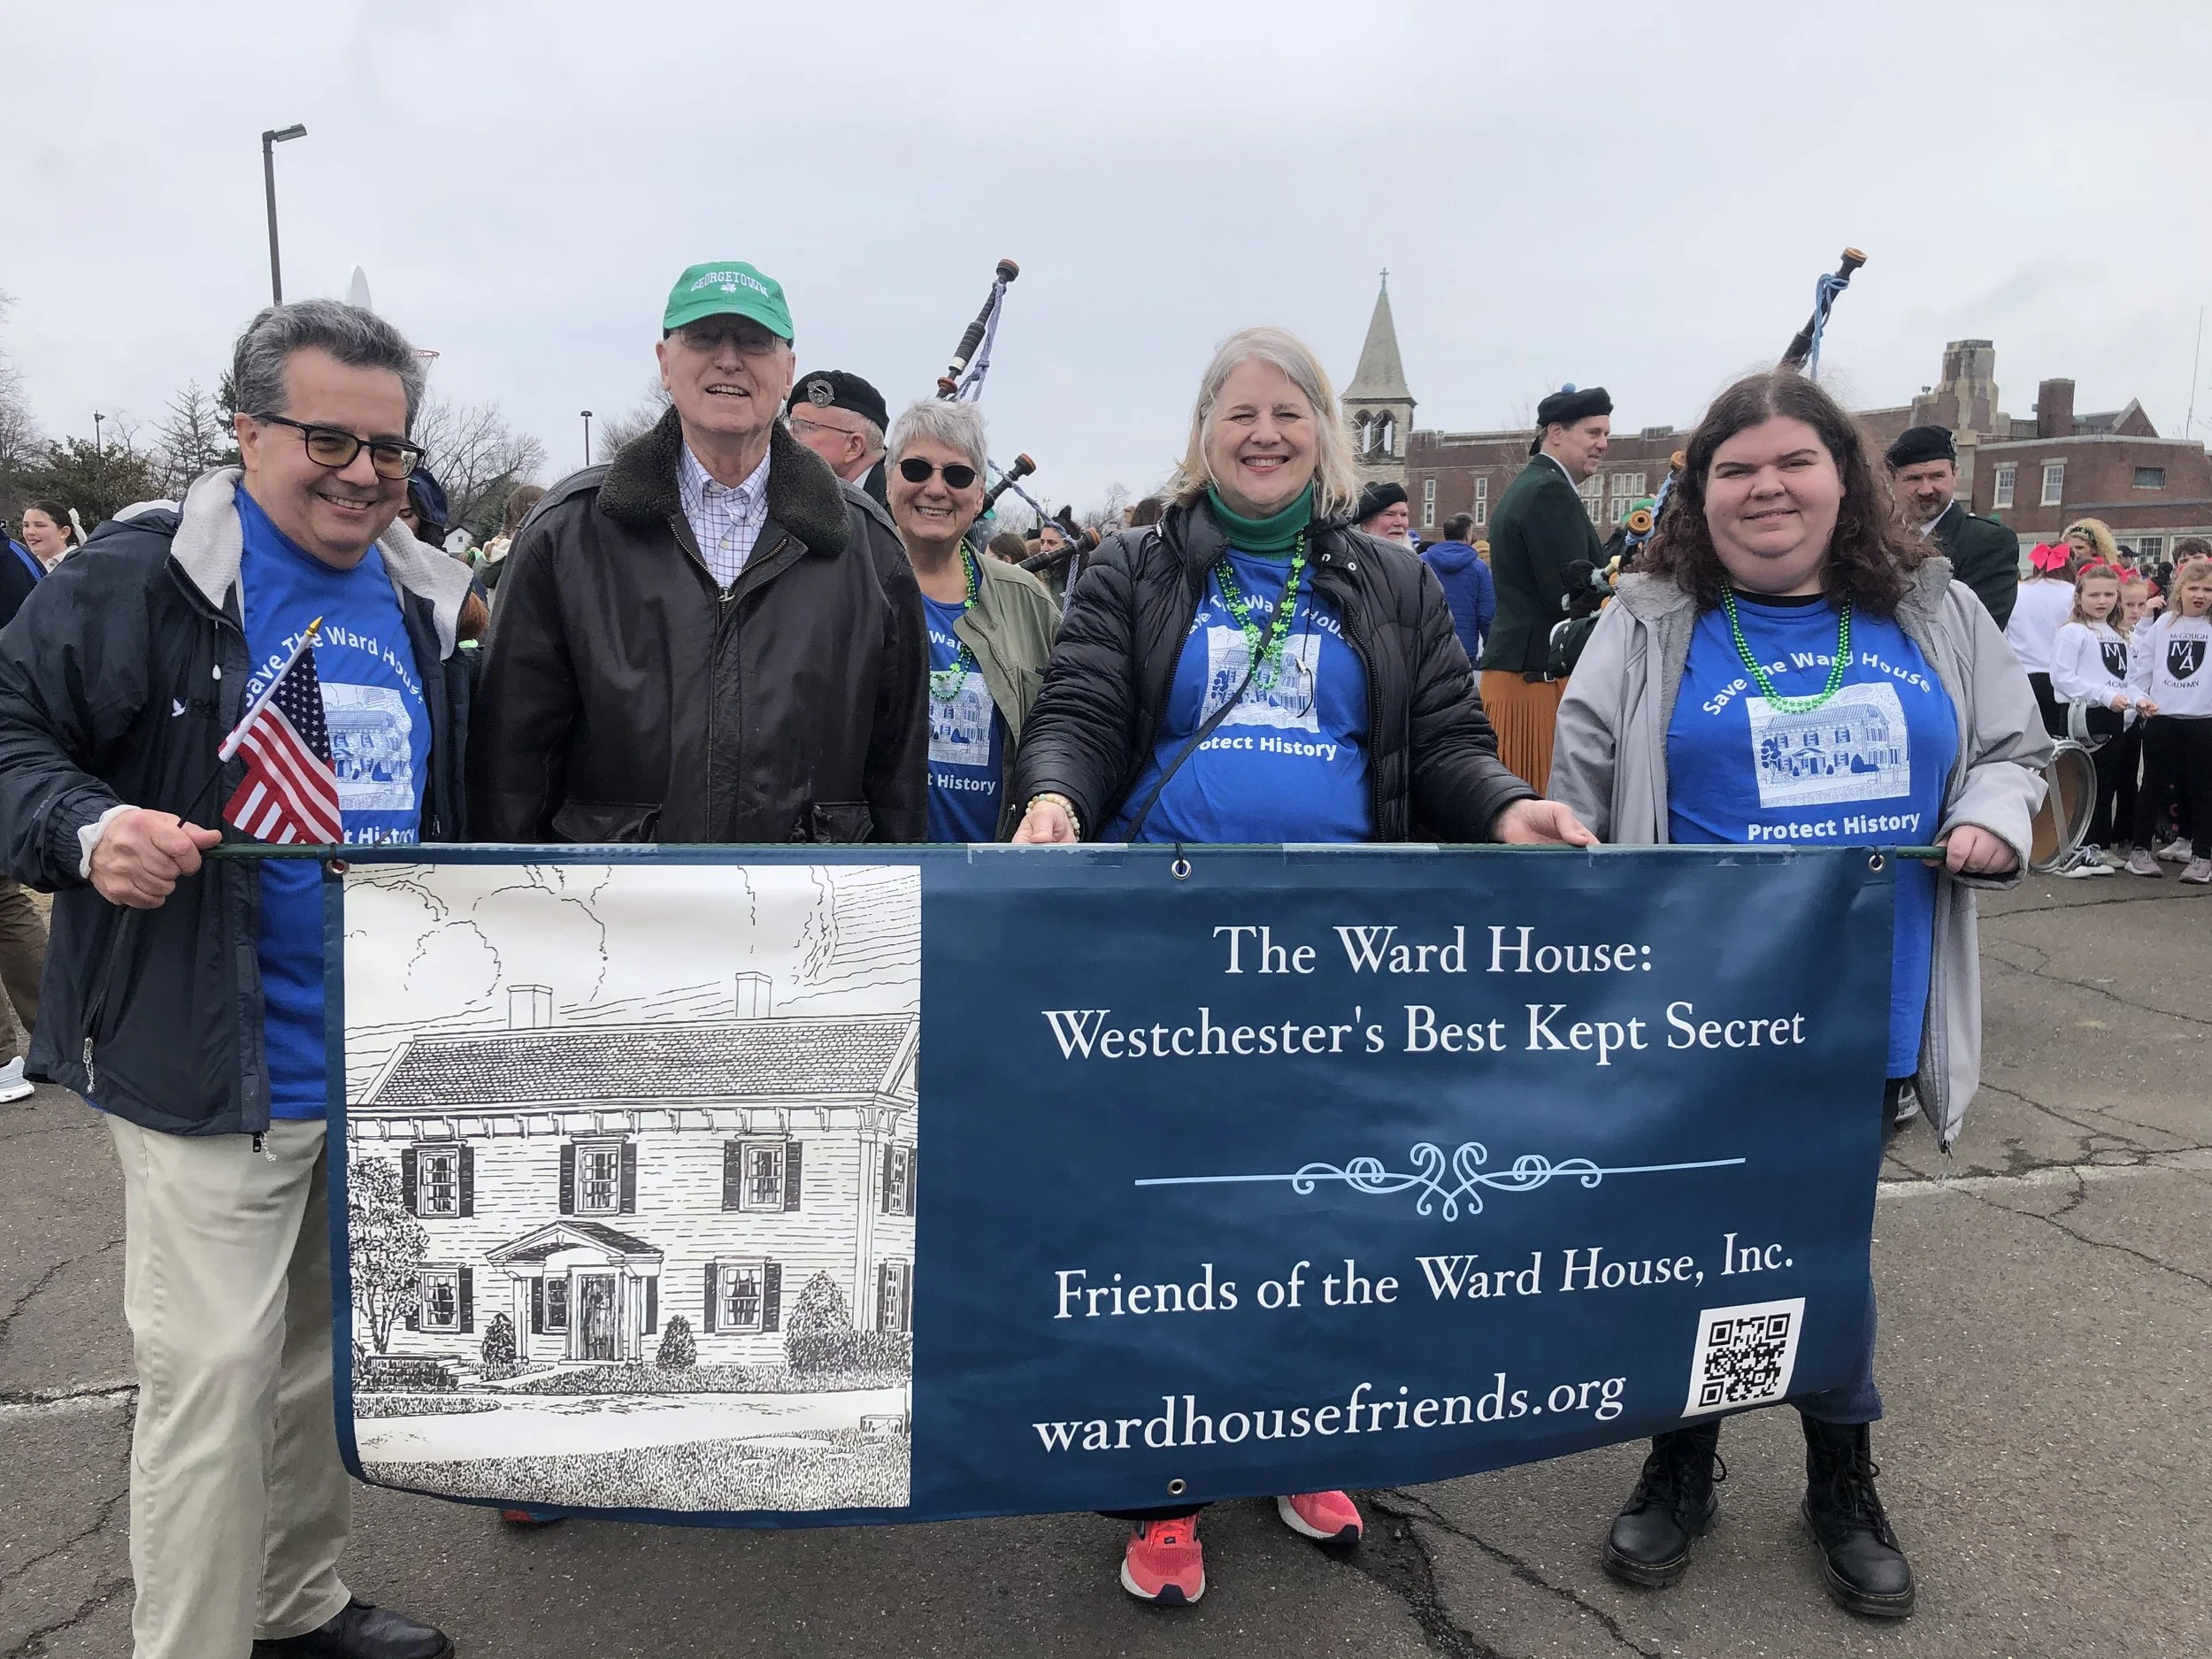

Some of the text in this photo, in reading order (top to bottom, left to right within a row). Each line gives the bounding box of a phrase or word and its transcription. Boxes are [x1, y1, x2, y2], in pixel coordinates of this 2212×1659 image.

[690, 271, 769, 298] GEORGETOWN
[1189, 613, 1212, 634] ave
[325, 626, 379, 656] Ward
[929, 630, 967, 654] War
[1703, 678, 1748, 716] Save
[1862, 652, 1931, 694] House
[1197, 736, 1337, 761] otect History
[937, 773, 996, 795] History
[1747, 812, 1921, 841] Protect History
[1213, 926, 1652, 974] The Ward House:
[1041, 1001, 1806, 1065] Westchester's Best Kept Secret
[1054, 1233, 1793, 1319] Friends of the Ward House, Inc.
[1033, 1372, 1626, 1452] wardhousefriends.org
